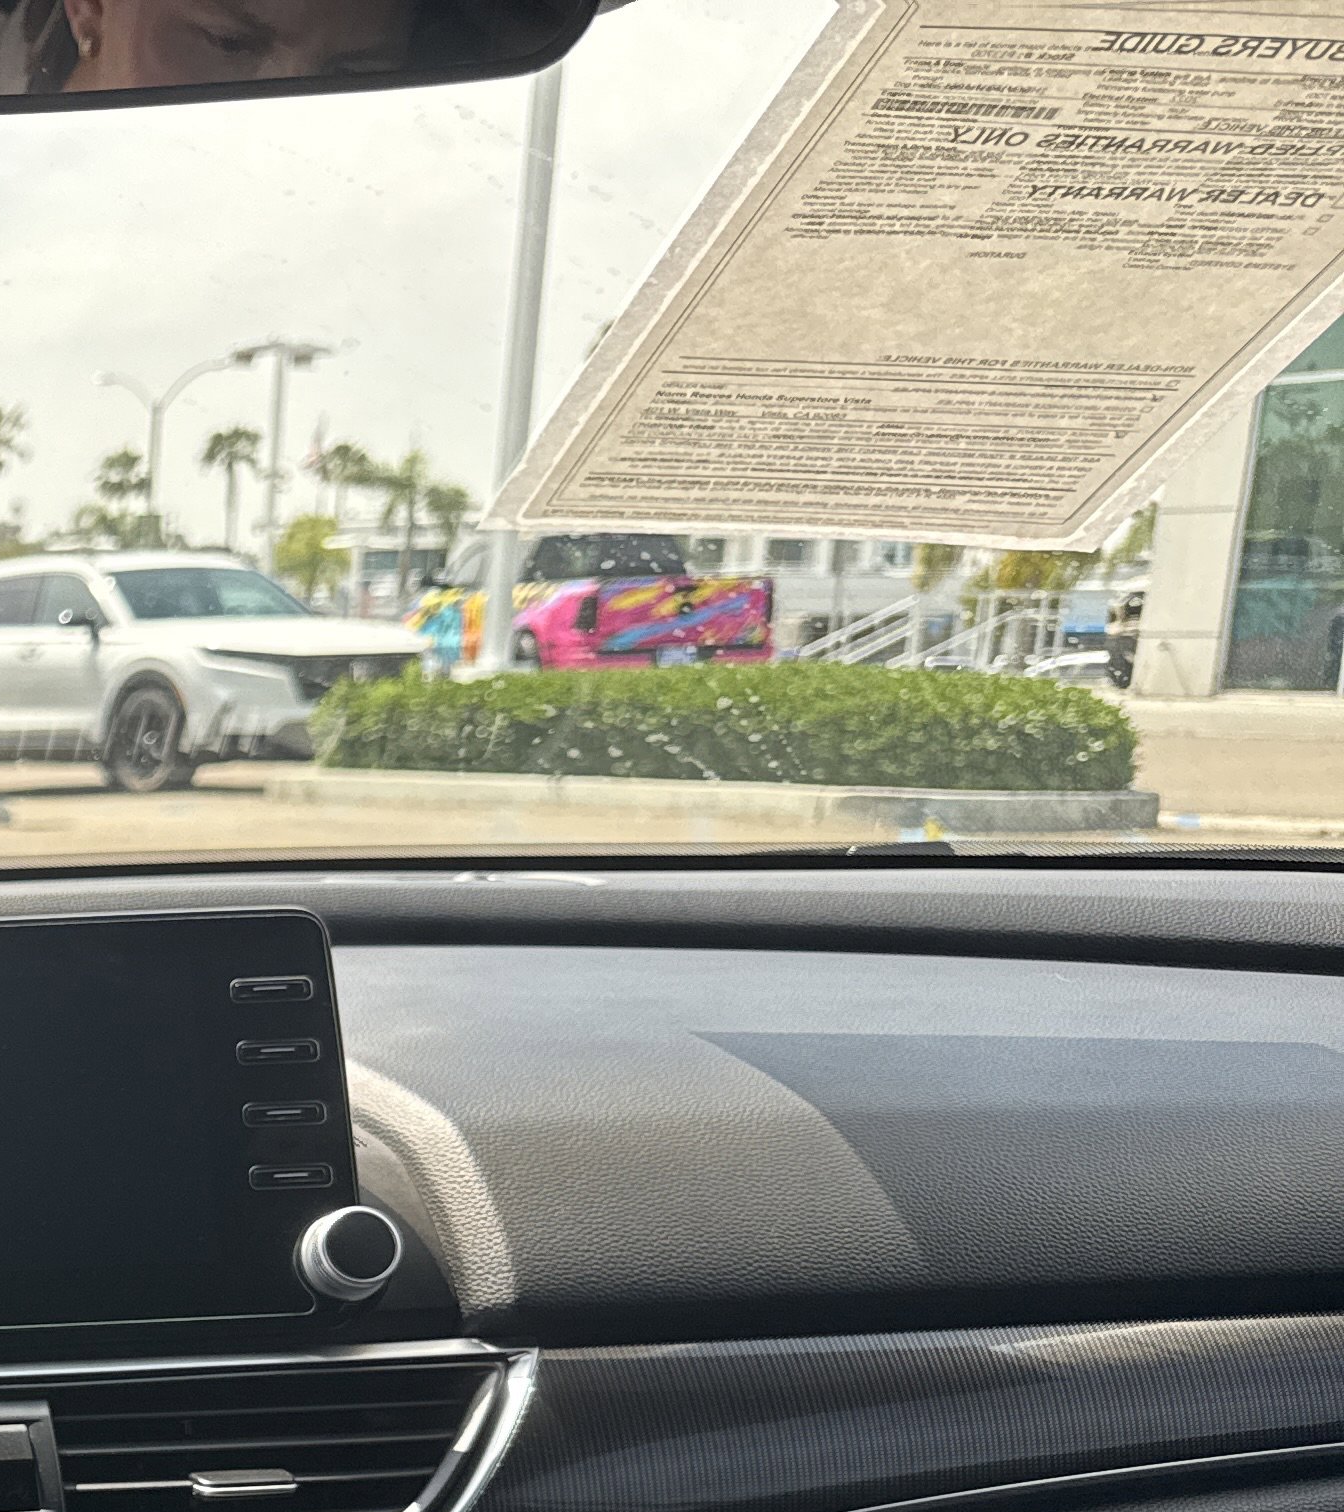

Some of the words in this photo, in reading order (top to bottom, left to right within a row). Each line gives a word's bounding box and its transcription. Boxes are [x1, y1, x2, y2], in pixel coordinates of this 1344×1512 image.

[655, 390, 688, 398] Norm
[690, 391, 732, 399] Reeves
[735, 393, 774, 401] Honda
[775, 394, 840, 404] Superstore
[843, 397, 873, 405] Vista
